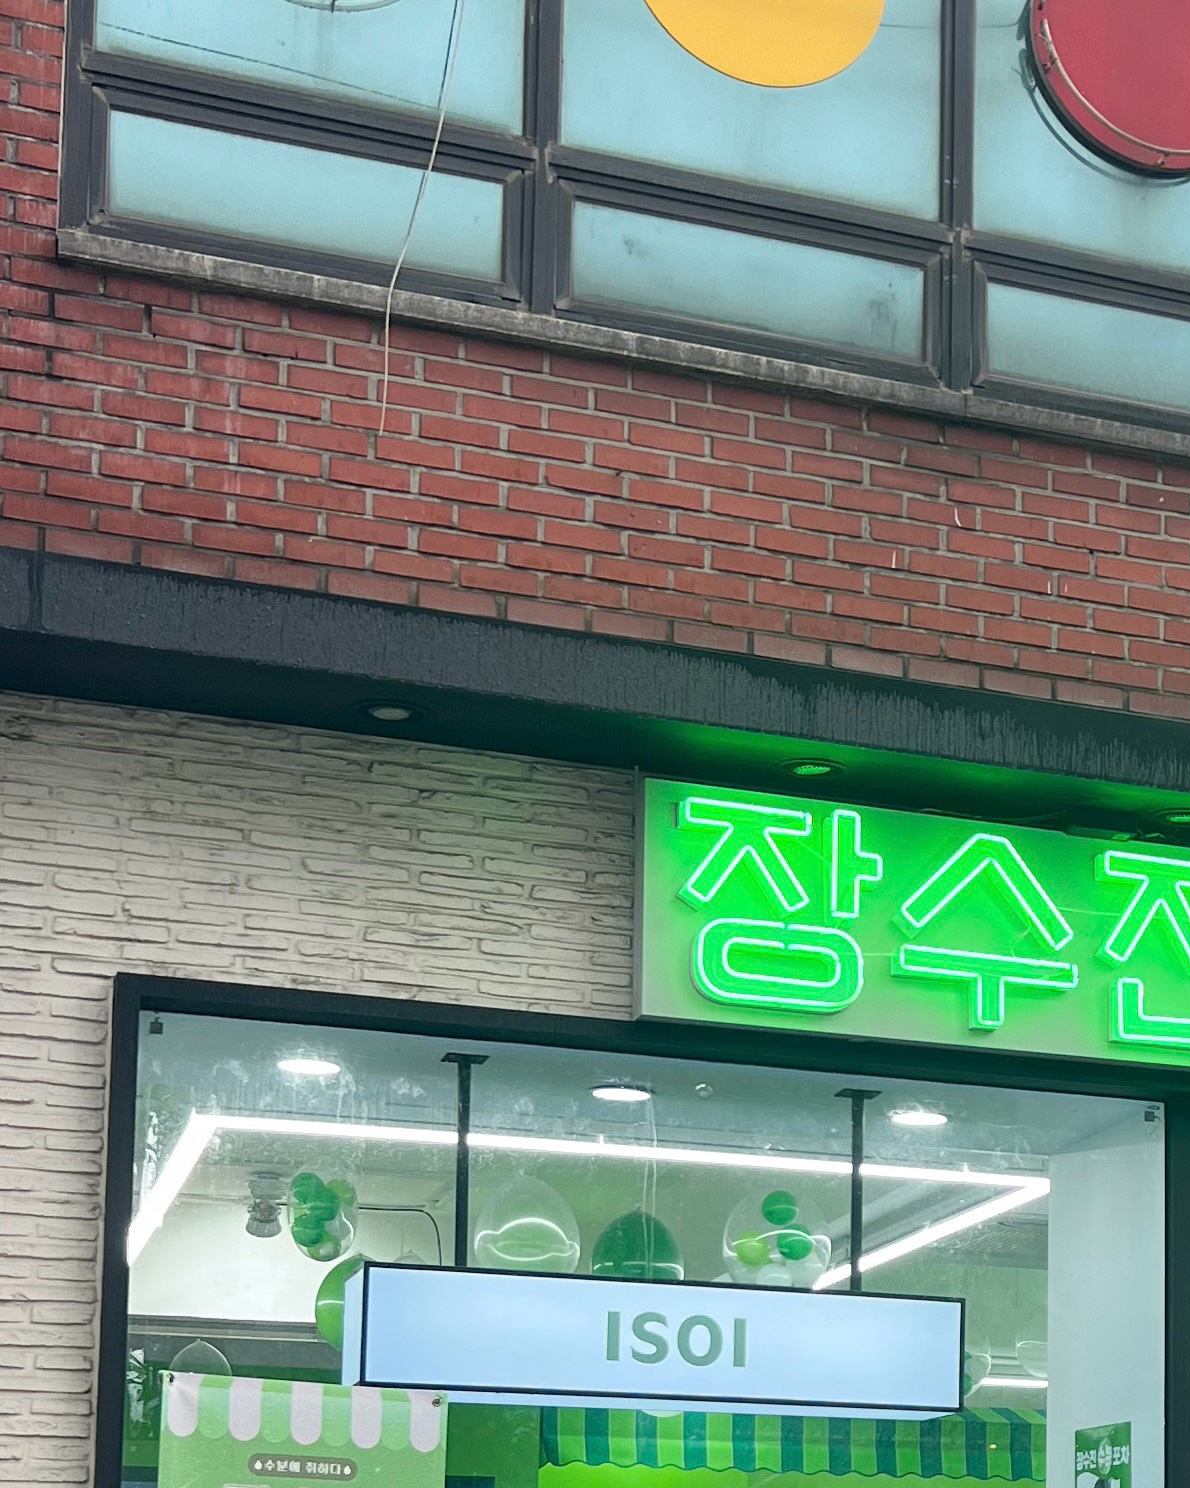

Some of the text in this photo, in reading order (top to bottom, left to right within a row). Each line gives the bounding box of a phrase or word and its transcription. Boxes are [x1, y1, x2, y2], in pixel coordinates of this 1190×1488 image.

[606, 1311, 748, 1368] ISOI
[265, 1460, 341, 1475] 수분에 취하다
